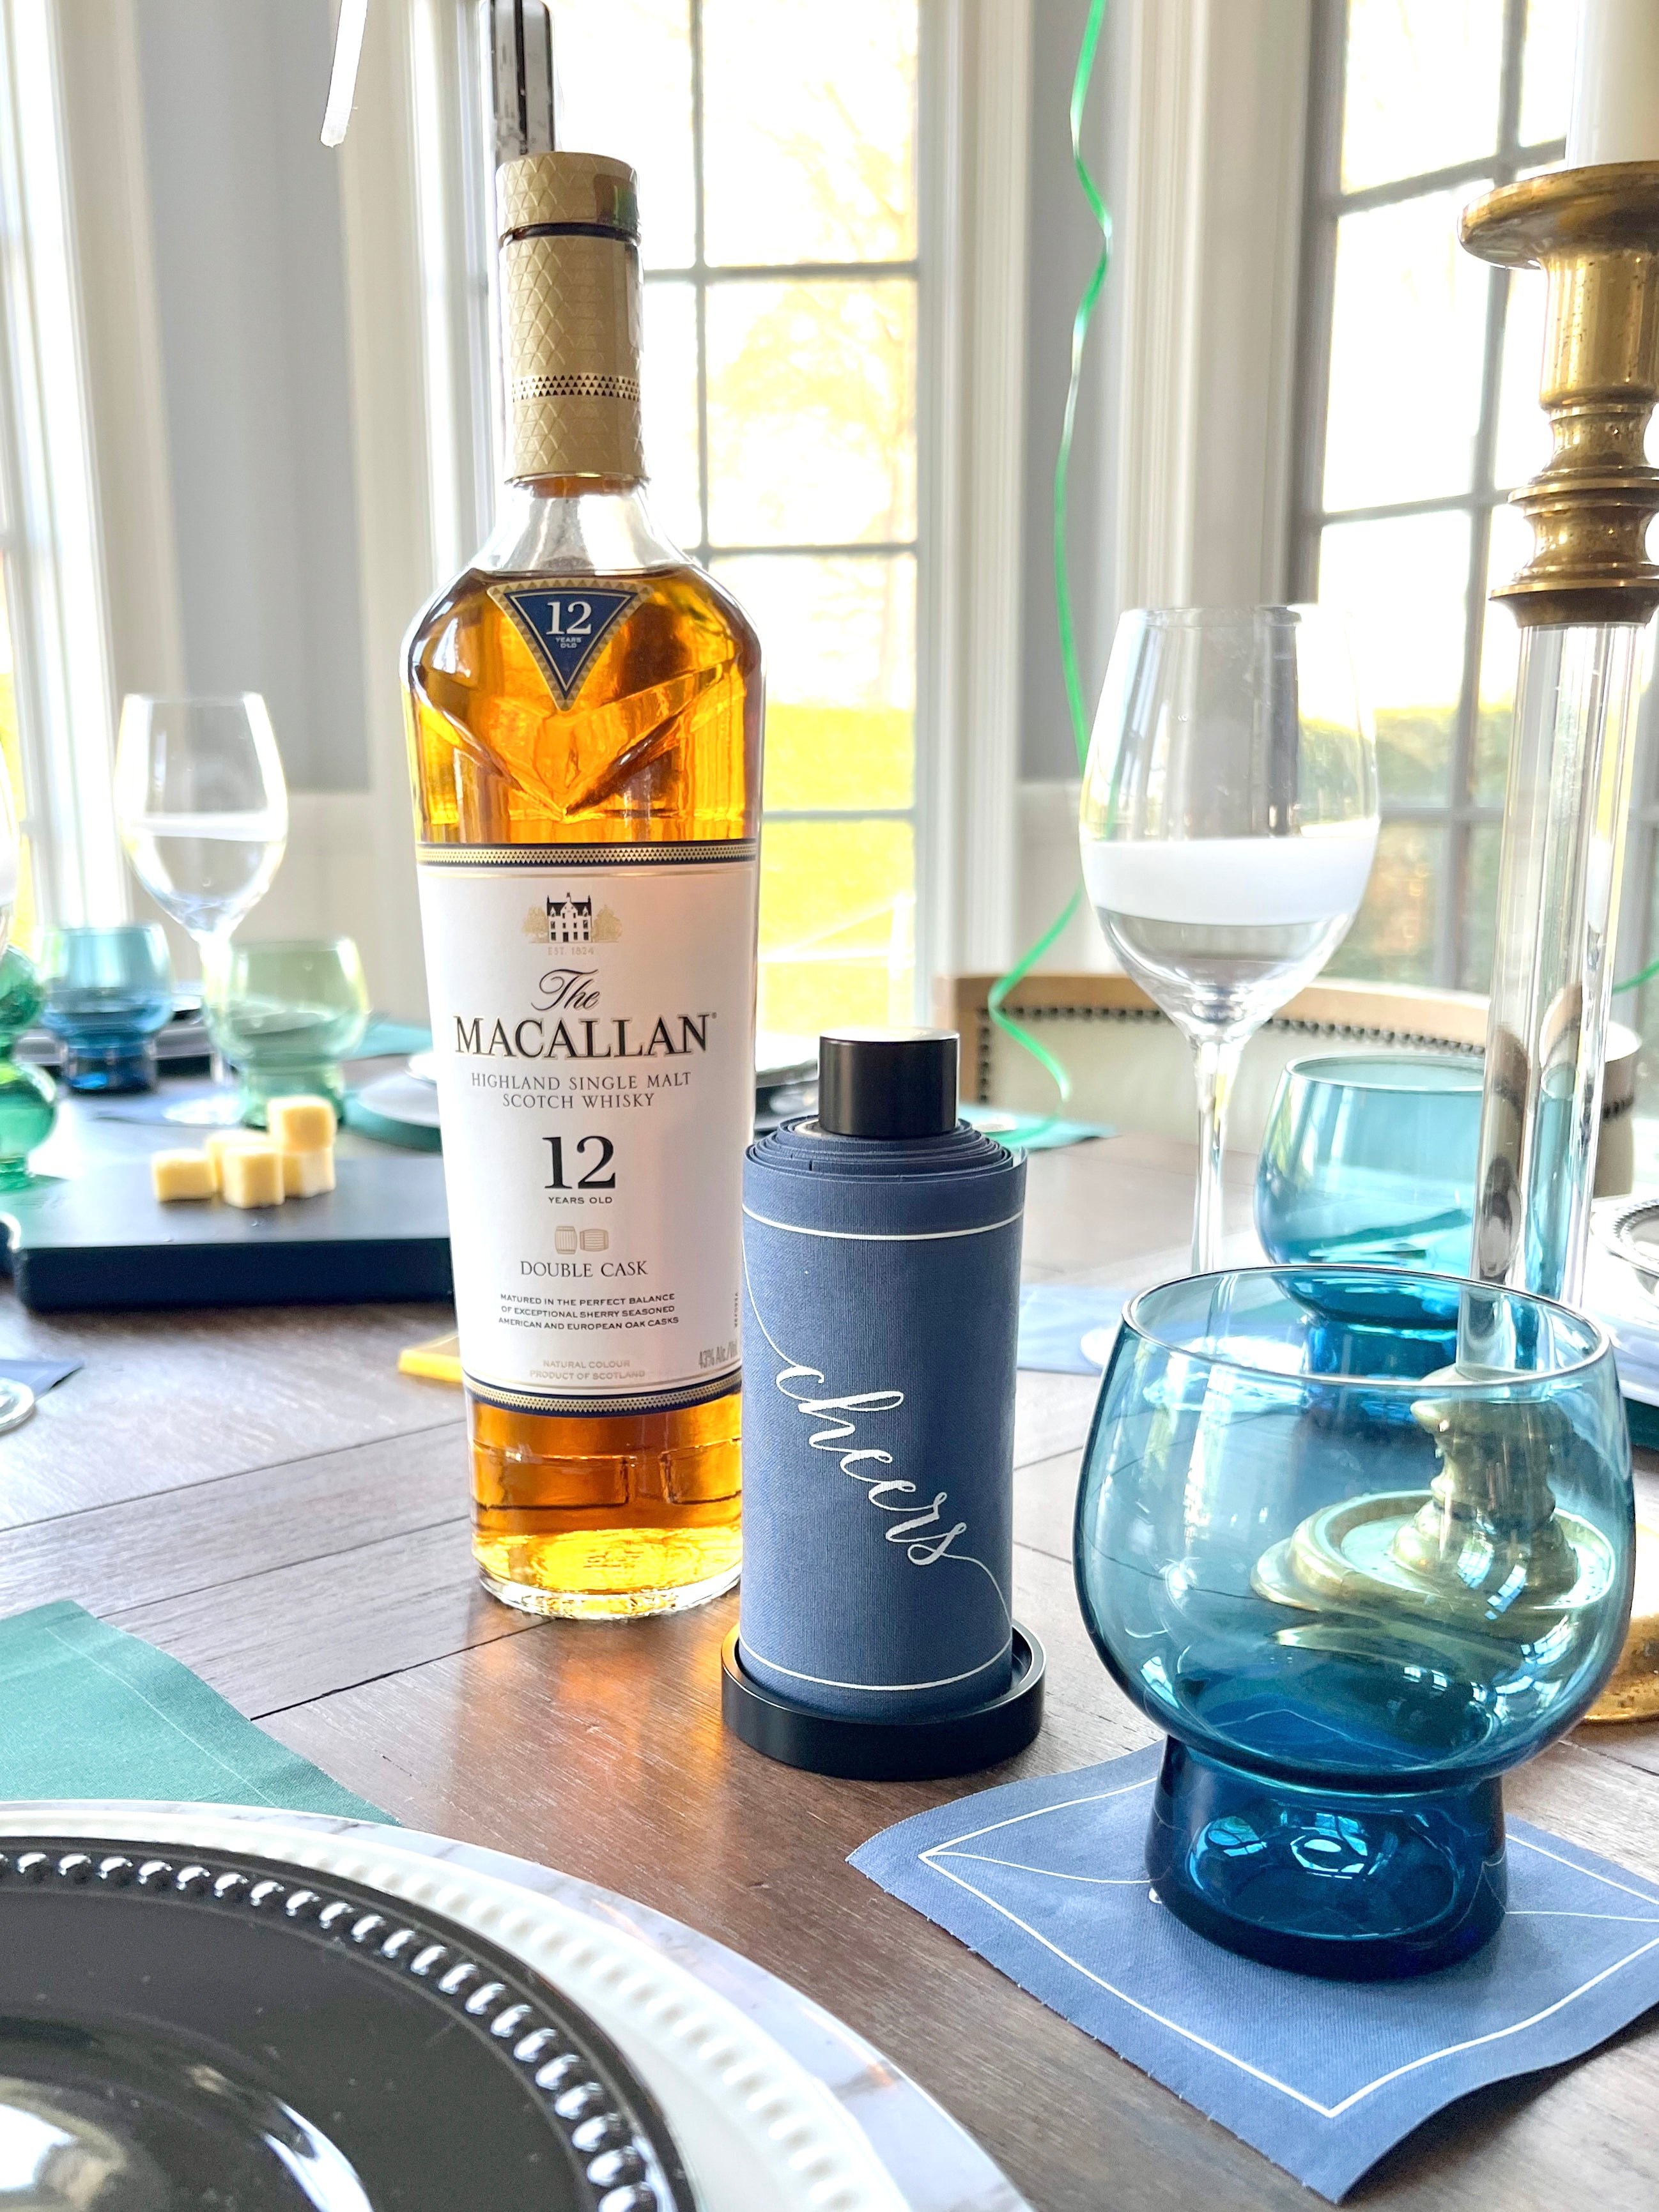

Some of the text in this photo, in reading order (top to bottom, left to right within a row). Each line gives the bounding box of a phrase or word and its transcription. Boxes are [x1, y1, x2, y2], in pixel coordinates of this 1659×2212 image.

[546, 601, 592, 635] 12
[530, 968, 600, 1011] The
[472, 1072, 691, 1091] HIGHLAND SINGLE MALT
[502, 1093, 654, 1109] SCOTCH WHISKY
[542, 1135, 616, 1189] 12
[521, 1261, 648, 1278] DOUBLE CASK
[500, 1293, 542, 1305] MATURED
[629, 1293, 675, 1305] BALANCE
[514, 1307, 578, 1318] EXCEPTIONAL
[622, 1305, 675, 1317] SEASONED
[498, 1317, 542, 1328] AMERICAN
[647, 1316, 679, 1327] CASKS
[543, 1360, 630, 1369] NATURAL COLOUR
[529, 1370, 573, 1380] PRODUCT
[592, 1370, 645, 1380] SCOTLAND
[775, 1363, 968, 1567] cheers
